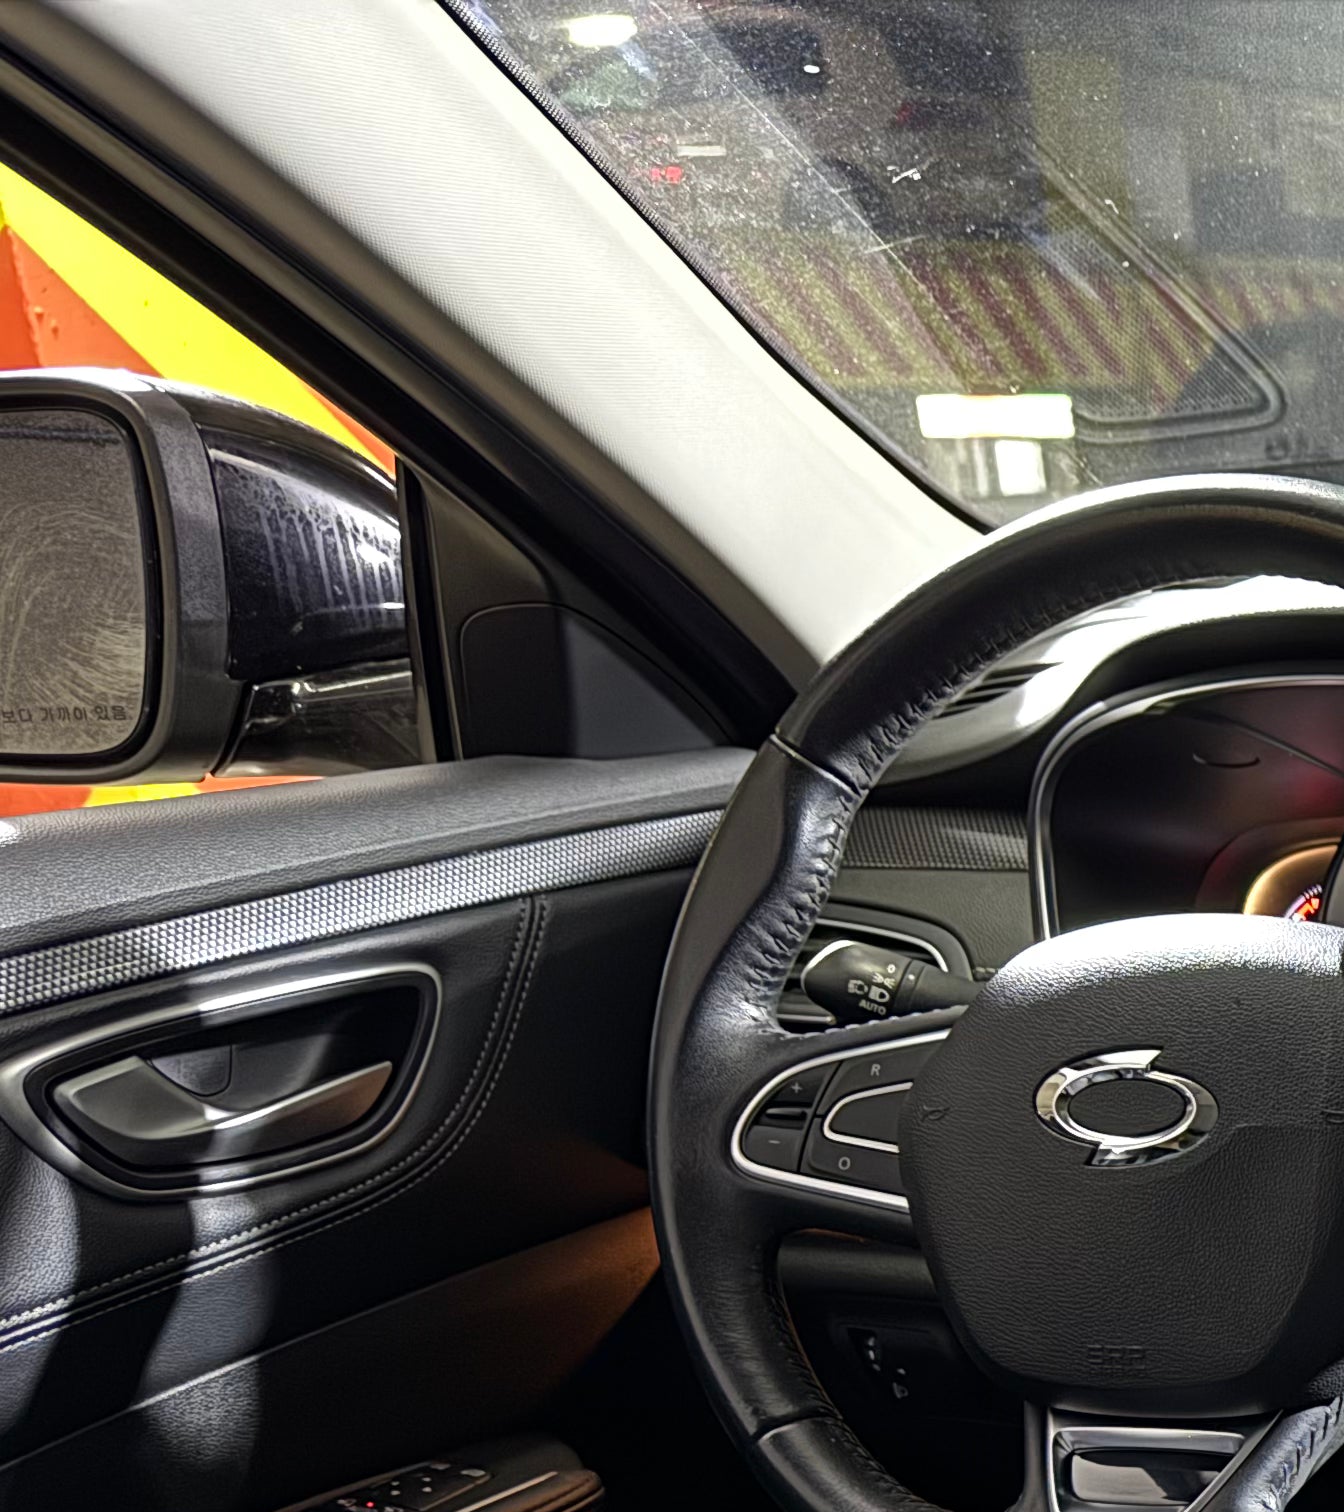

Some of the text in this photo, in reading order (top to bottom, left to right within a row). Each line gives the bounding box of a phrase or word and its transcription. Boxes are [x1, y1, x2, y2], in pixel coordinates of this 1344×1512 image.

[40, 706, 88, 722] 가까이
[858, 999, 887, 1016] AUTO
[870, 1063, 881, 1076] R
